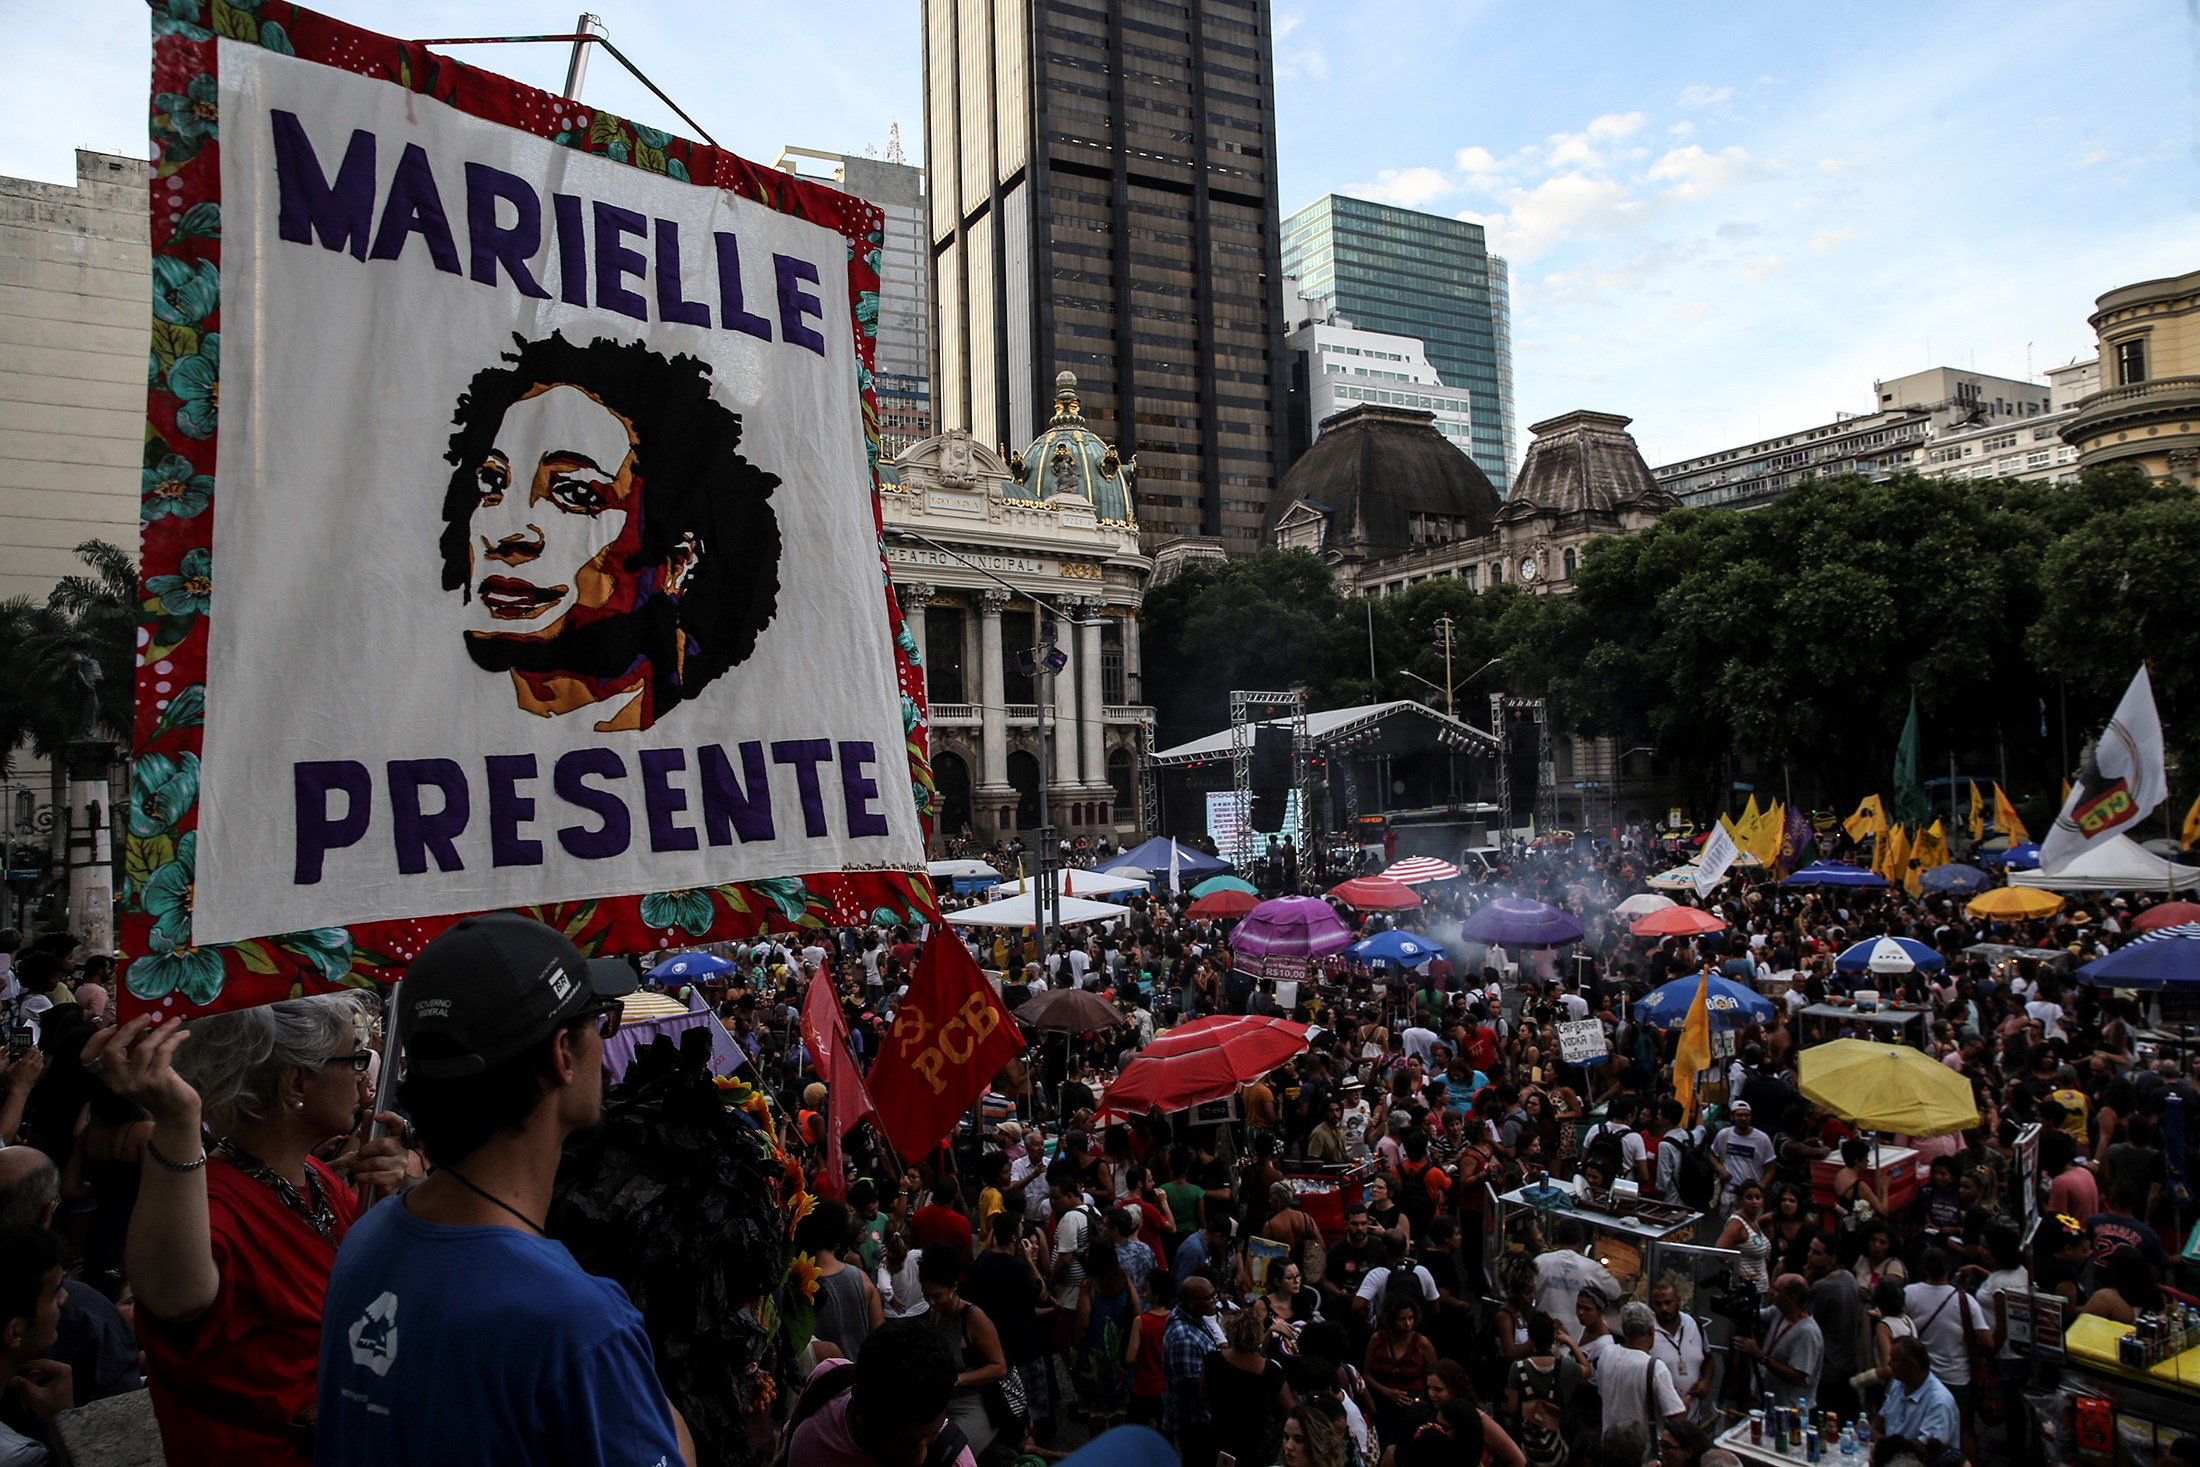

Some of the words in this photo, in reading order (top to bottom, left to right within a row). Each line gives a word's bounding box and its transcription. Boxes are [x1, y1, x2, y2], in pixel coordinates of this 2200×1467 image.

[270, 109, 825, 357] MARIELLE
[888, 549, 947, 564] HEATRO
[956, 554, 1033, 572] MUNICIPAL
[293, 738, 889, 884] PRESENTE
[415, 998, 452, 1010] GOVERNO
[417, 1007, 449, 1018] FEDERAL
[911, 991, 1000, 1096] PCB
[1561, 1035, 1587, 1048] VODKA
